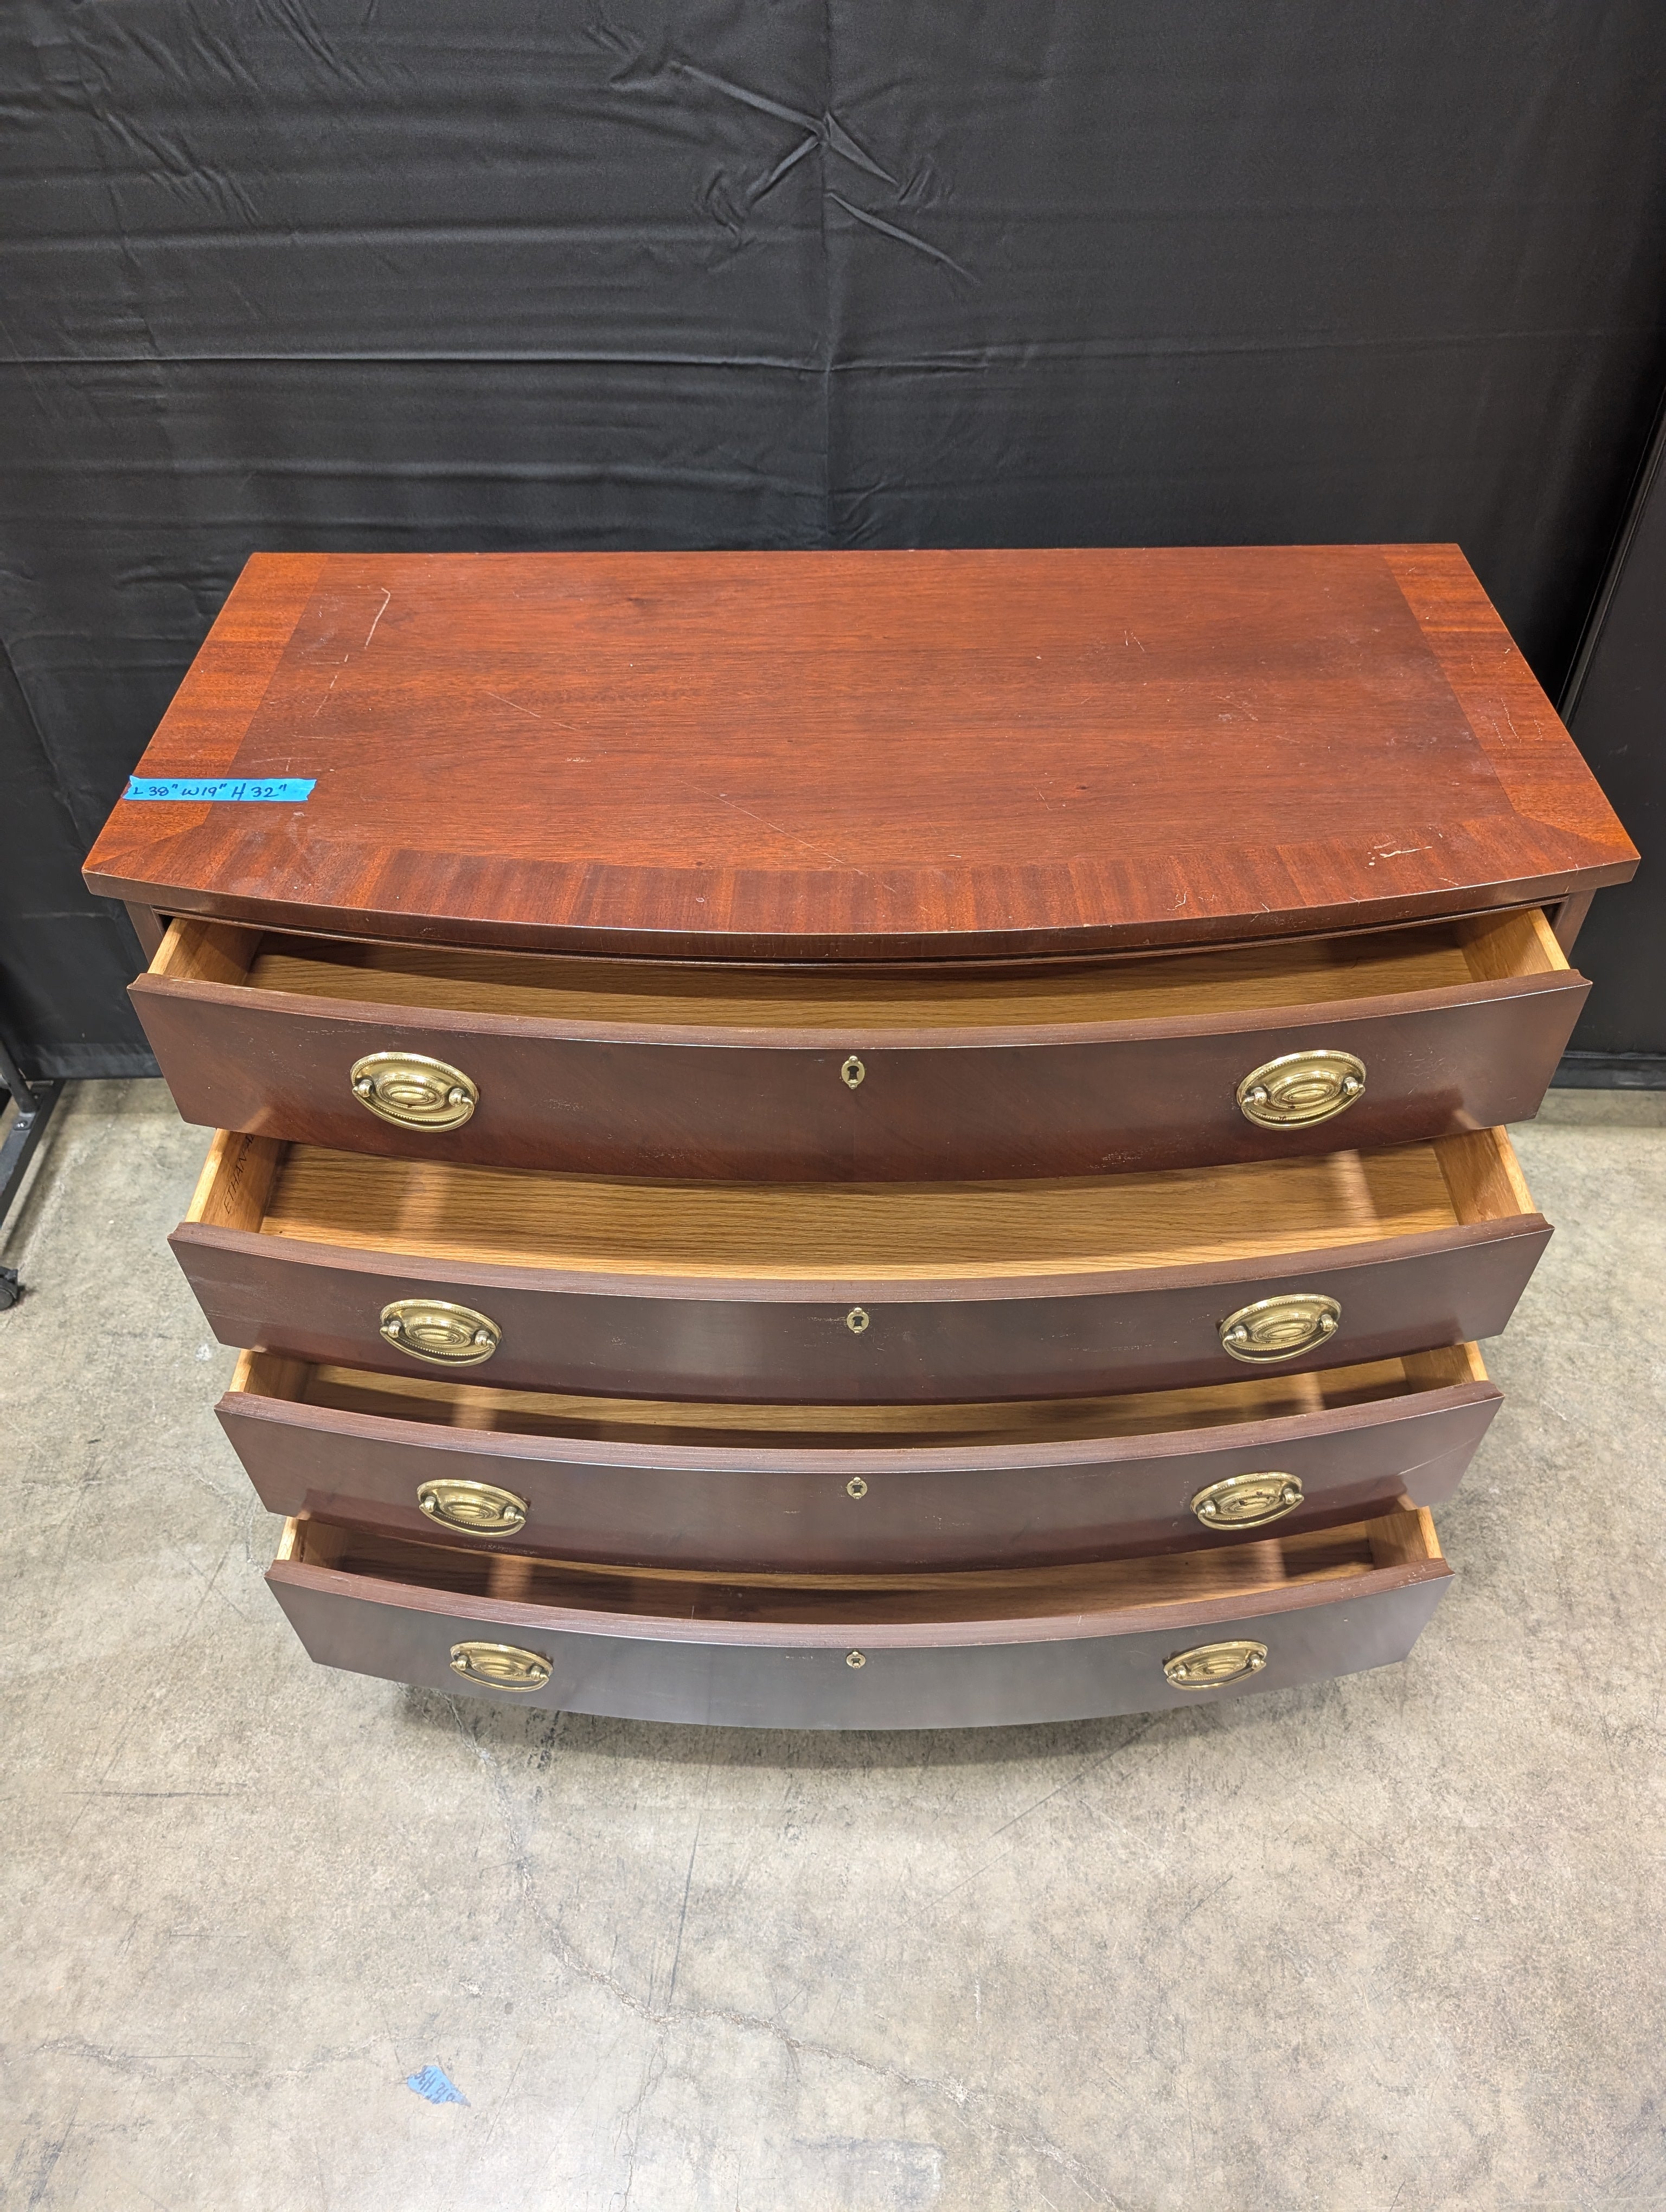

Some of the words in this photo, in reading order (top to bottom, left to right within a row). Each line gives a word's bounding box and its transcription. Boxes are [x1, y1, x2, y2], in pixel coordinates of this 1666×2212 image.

[133, 787, 143, 795] L
[149, 783, 178, 796] 38"
[251, 783, 287, 798] 32"
[223, 1149, 247, 1214] ETHAN
